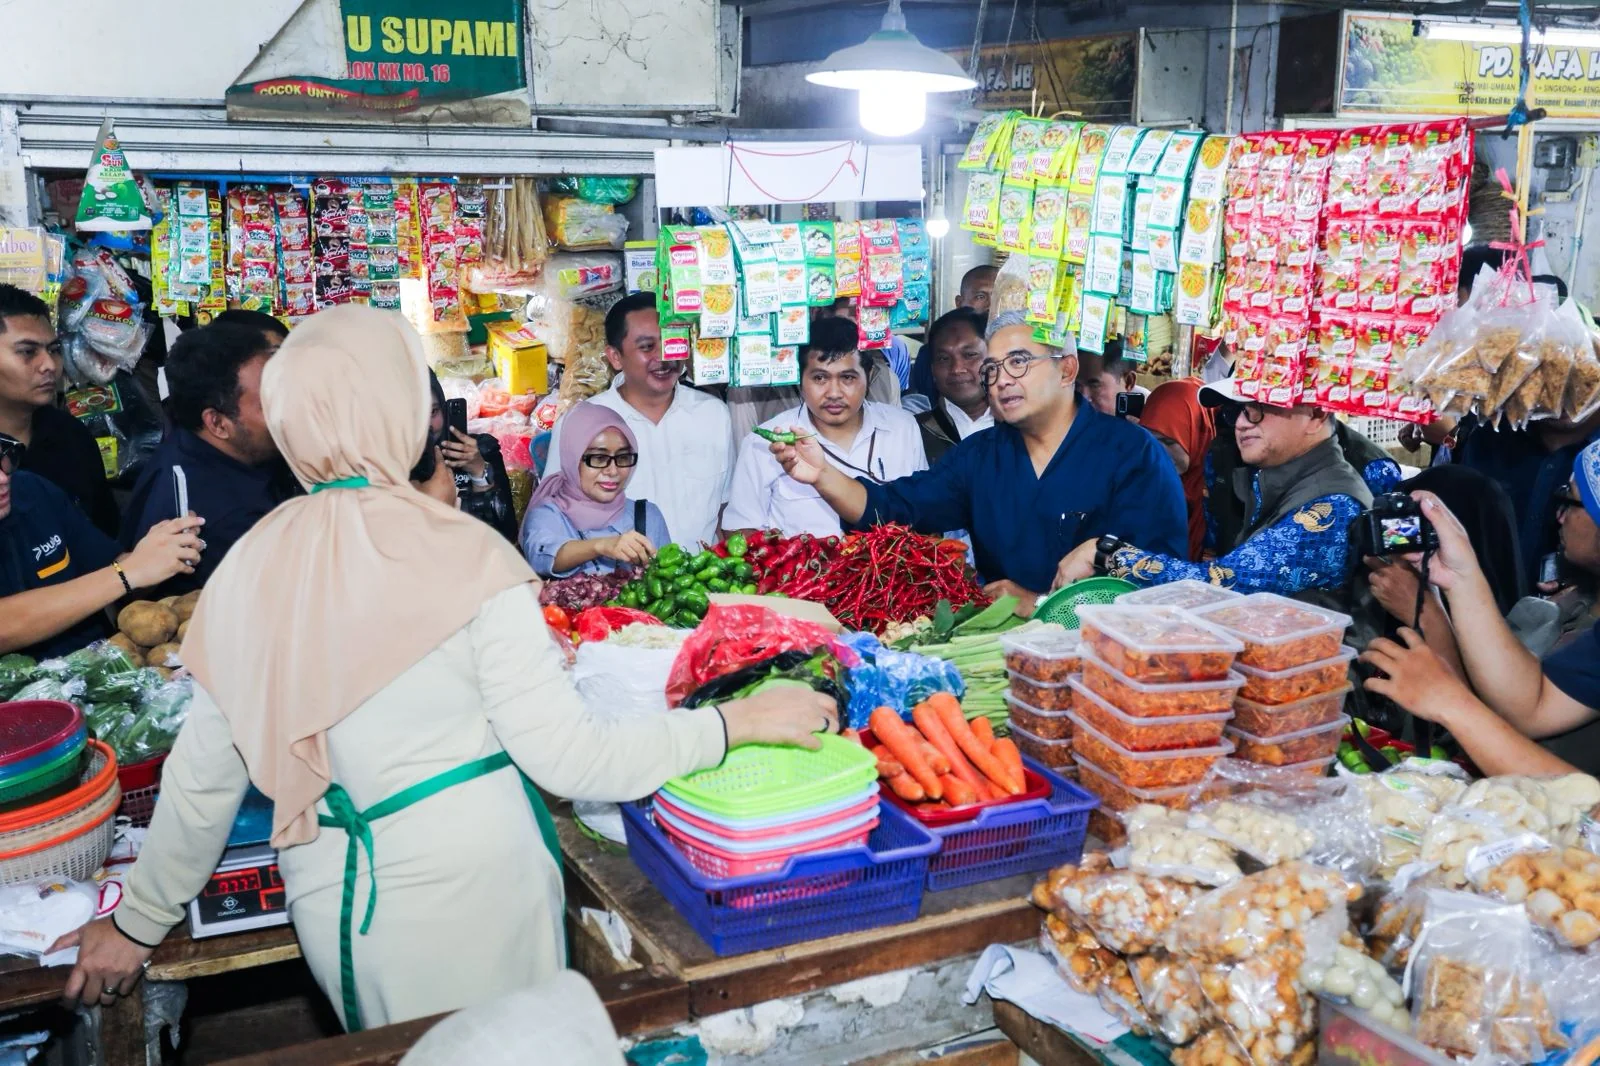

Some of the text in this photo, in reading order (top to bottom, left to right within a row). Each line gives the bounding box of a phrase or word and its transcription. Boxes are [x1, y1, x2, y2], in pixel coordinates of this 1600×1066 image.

[381, 16, 517, 56] SUPAMI
[403, 64, 429, 82] NO.
[431, 64, 450, 83] 16
[1479, 46, 1513, 77] PD.
[1012, 64, 1034, 90] HB
[260, 85, 301, 96] COCOK
